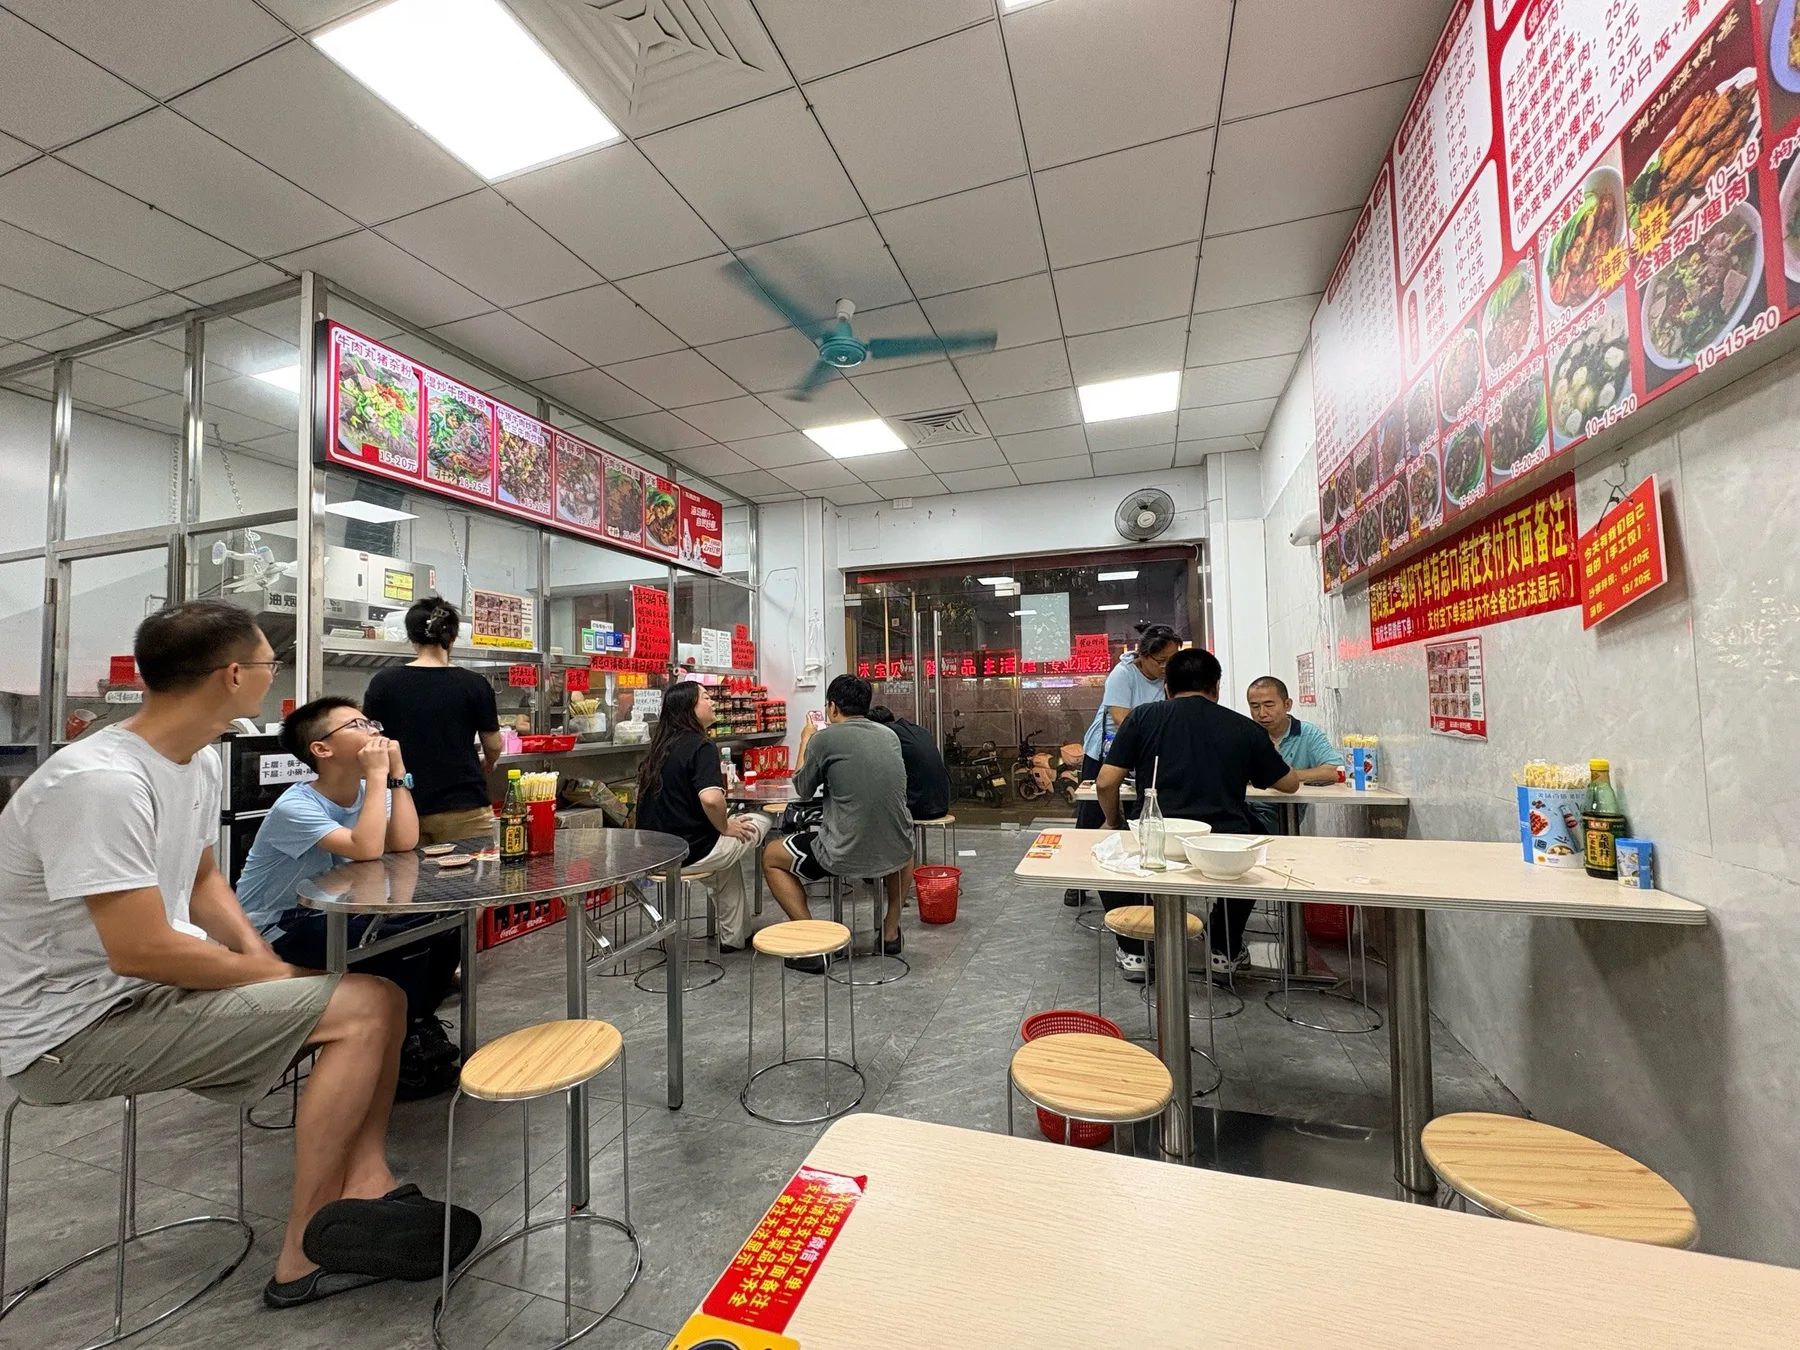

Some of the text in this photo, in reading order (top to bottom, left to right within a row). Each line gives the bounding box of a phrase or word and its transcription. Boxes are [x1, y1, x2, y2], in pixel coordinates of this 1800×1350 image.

[1607, 3, 1640, 59] 23元
[1609, 33, 1642, 88] 23元
[337, 333, 412, 378] 牛肉丸猪杂粉
[1697, 308, 1778, 371] 10-15-20
[426, 374, 487, 411] 湿炒牛肉粿条
[556, 435, 585, 459] 海鲜粥
[1584, 502, 1646, 561] 今天有我们自己
[1620, 548, 1650, 576] 15/20元
[1621, 569, 1651, 596] 15/20元
[728, 1182, 820, 1308] 支付宝下单菜品不齐全
[730, 1194, 795, 1272] 备注无法显示!
